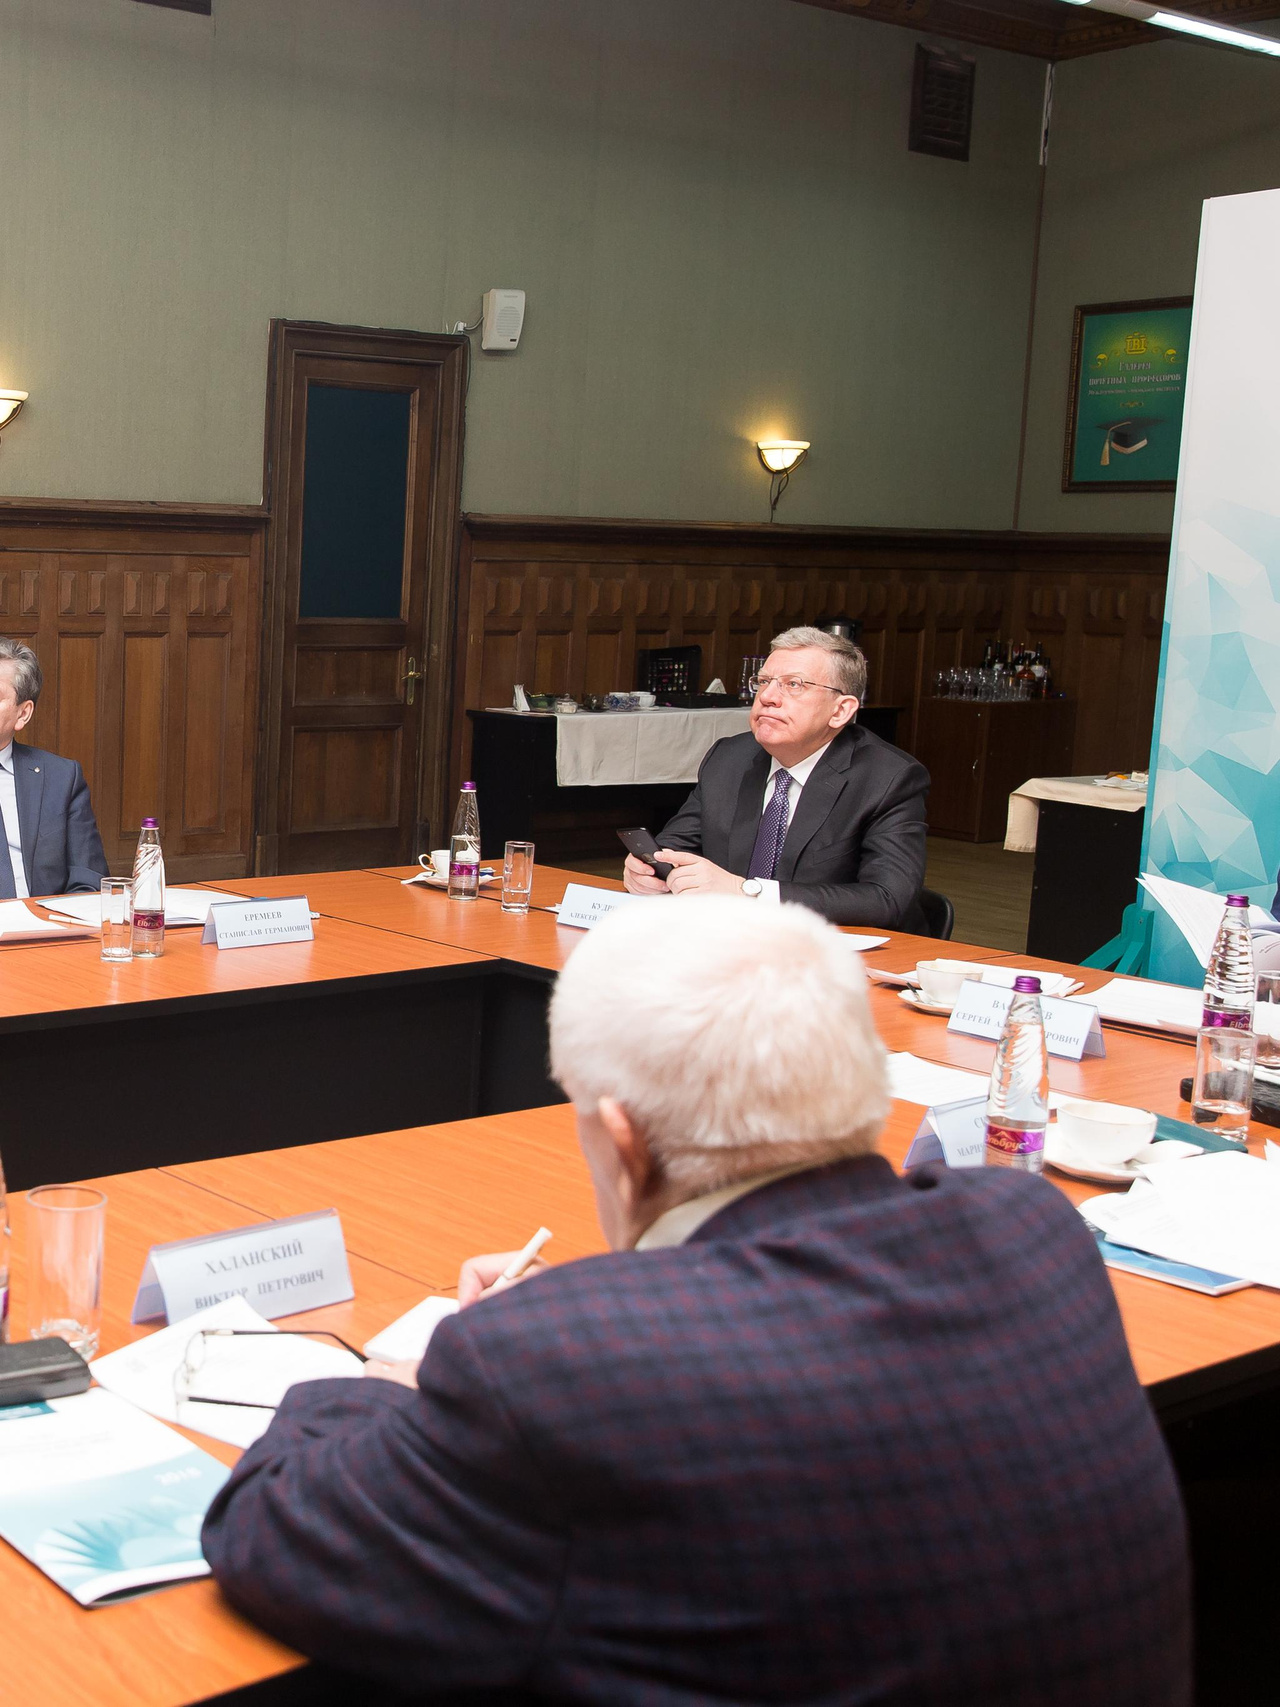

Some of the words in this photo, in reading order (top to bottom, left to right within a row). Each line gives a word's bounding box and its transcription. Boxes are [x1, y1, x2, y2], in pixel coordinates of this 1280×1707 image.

[592, 902, 616, 911] КУДР
[244, 911, 282, 922] ЕРЕМЕЕВ
[219, 929, 263, 939] СТАНИСЛАВ
[265, 924, 310, 935] ГЕРМАНОВИЧ
[956, 1011, 991, 1025] СЕРГЕЙ
[205, 1239, 304, 1275] ХАЛАНСКИЙ
[257, 1269, 324, 1295] ПЕТРОВИЧ
